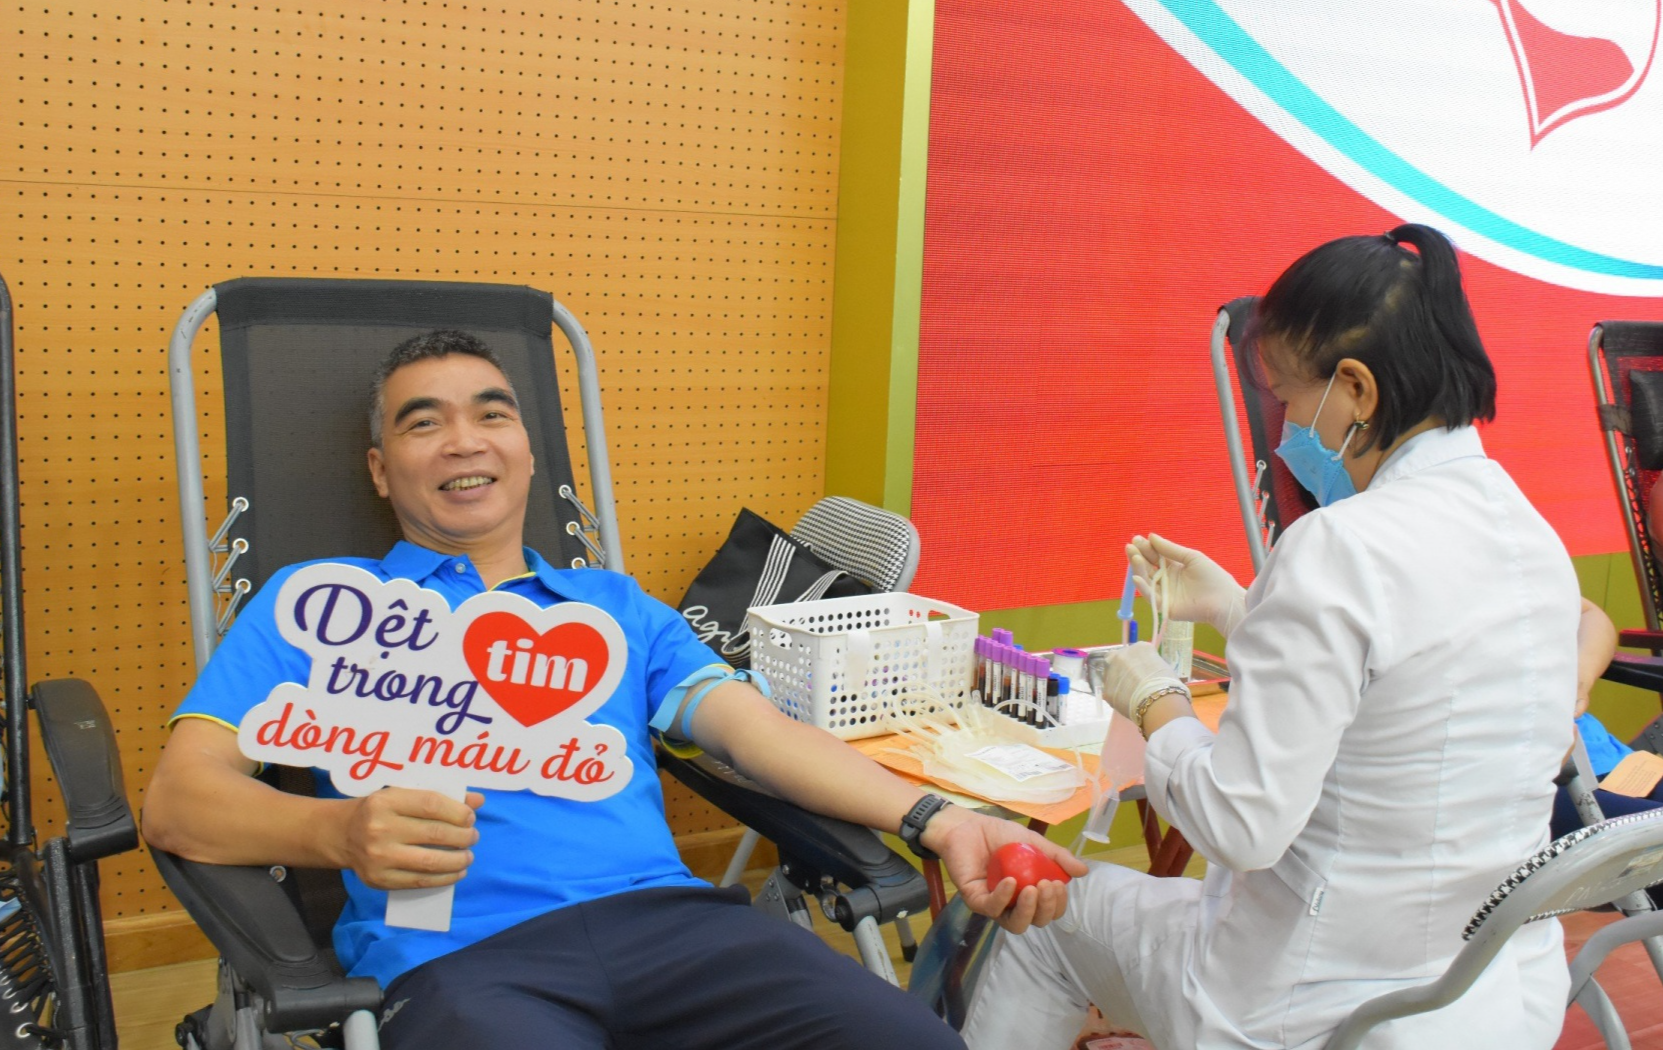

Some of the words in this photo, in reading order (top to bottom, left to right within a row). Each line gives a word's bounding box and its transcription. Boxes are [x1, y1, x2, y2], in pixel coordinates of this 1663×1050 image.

[293, 583, 439, 660] Dệt
[326, 656, 493, 736] trong
[486, 638, 589, 692] tim
[256, 702, 404, 780] dòng
[408, 731, 530, 775] máu
[540, 737, 615, 785] đỏ
